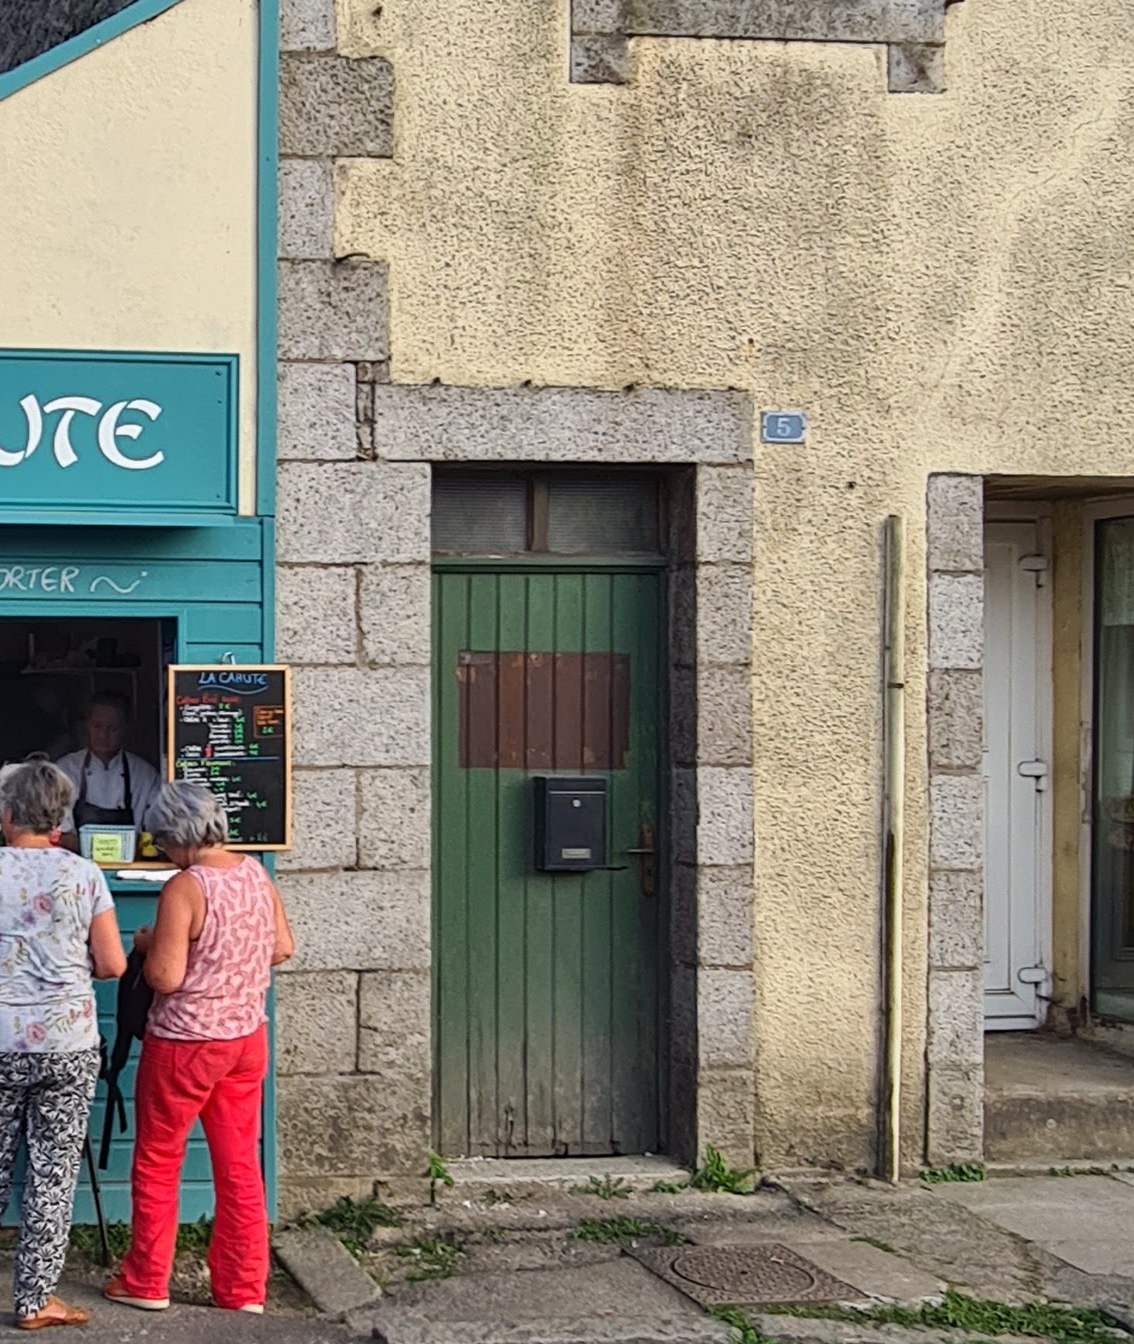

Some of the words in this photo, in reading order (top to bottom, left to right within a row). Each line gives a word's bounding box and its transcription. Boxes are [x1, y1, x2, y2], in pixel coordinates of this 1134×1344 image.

[776, 417, 792, 437] 5
[198, 672, 217, 685] LA
[218, 672, 268, 686] CAHUTE
